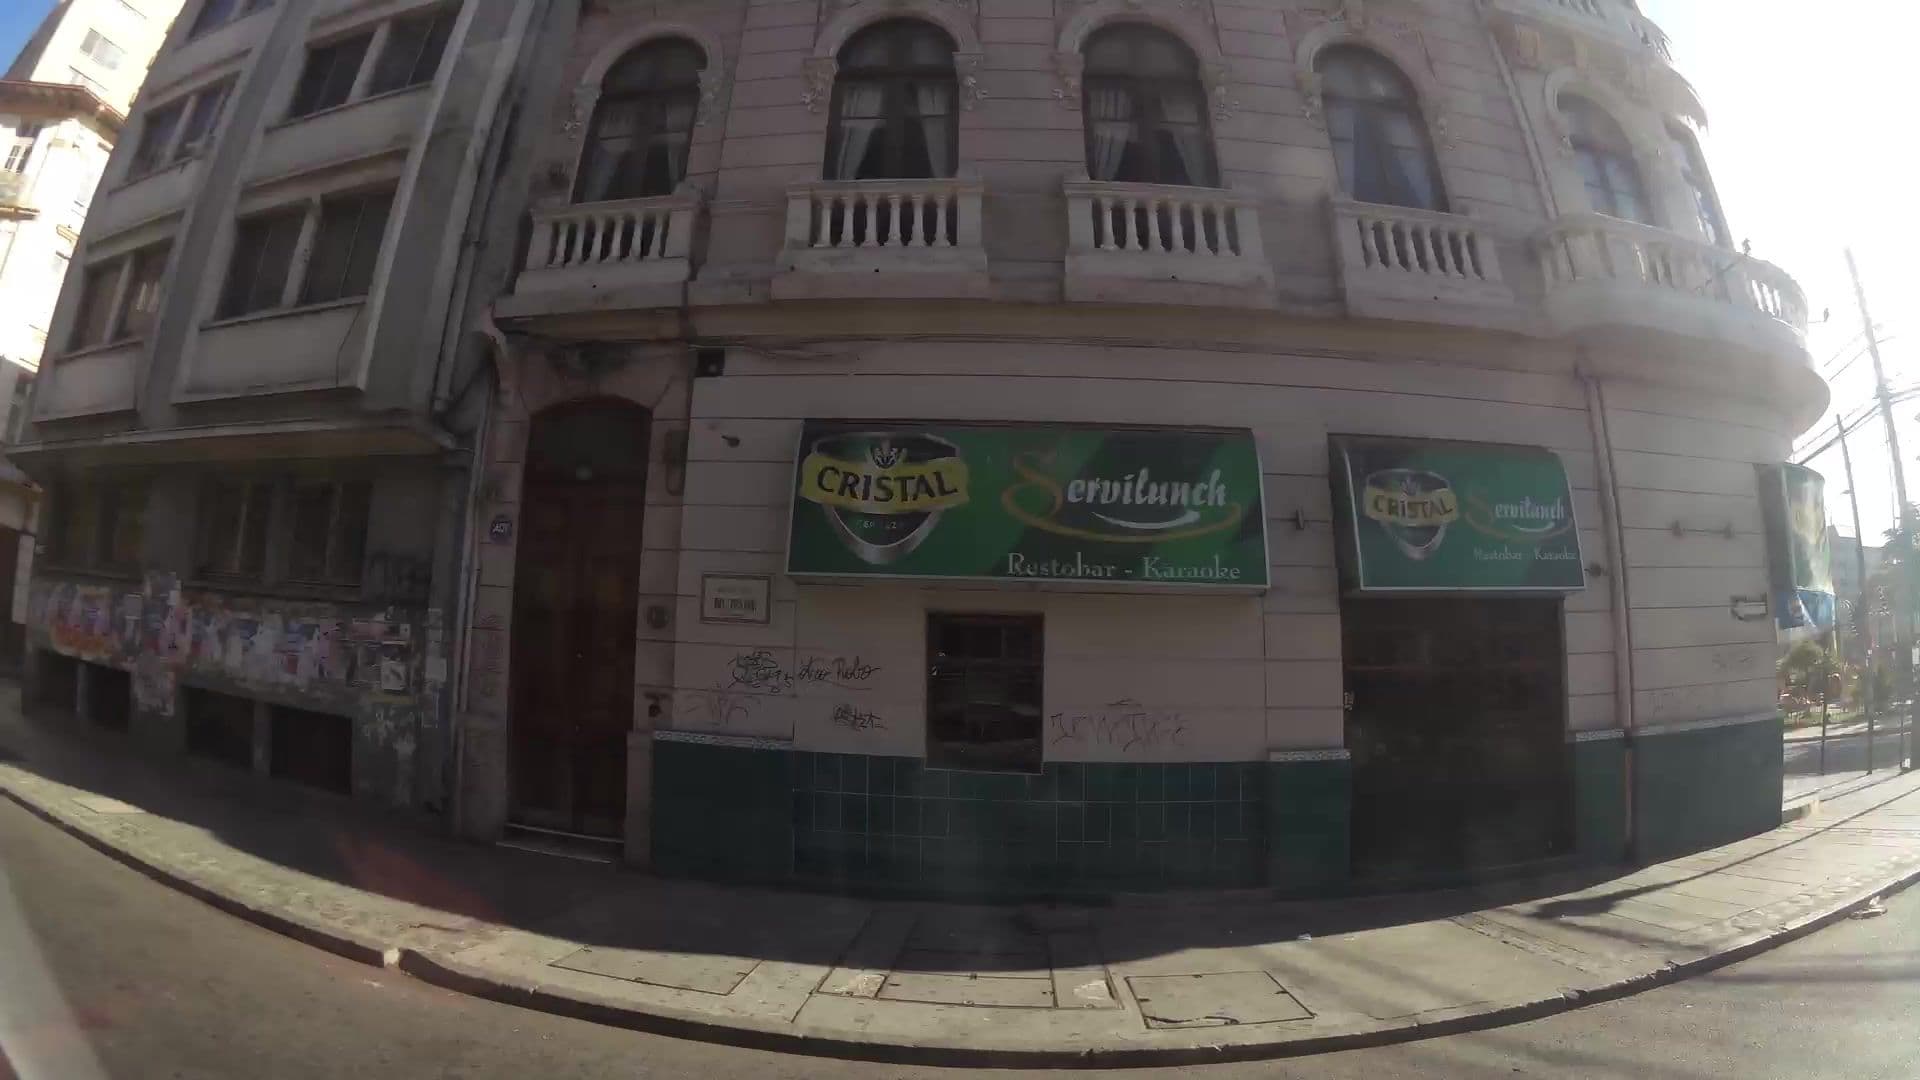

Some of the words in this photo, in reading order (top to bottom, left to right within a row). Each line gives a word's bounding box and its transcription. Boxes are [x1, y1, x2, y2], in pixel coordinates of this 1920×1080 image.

[816, 465, 959, 503] CRISTAL
[1001, 449, 1233, 528] Servilunch
[1373, 494, 1454, 518] CRISTAL
[1007, 551, 1116, 578] Restobar
[1142, 554, 1241, 580] Karaoke
